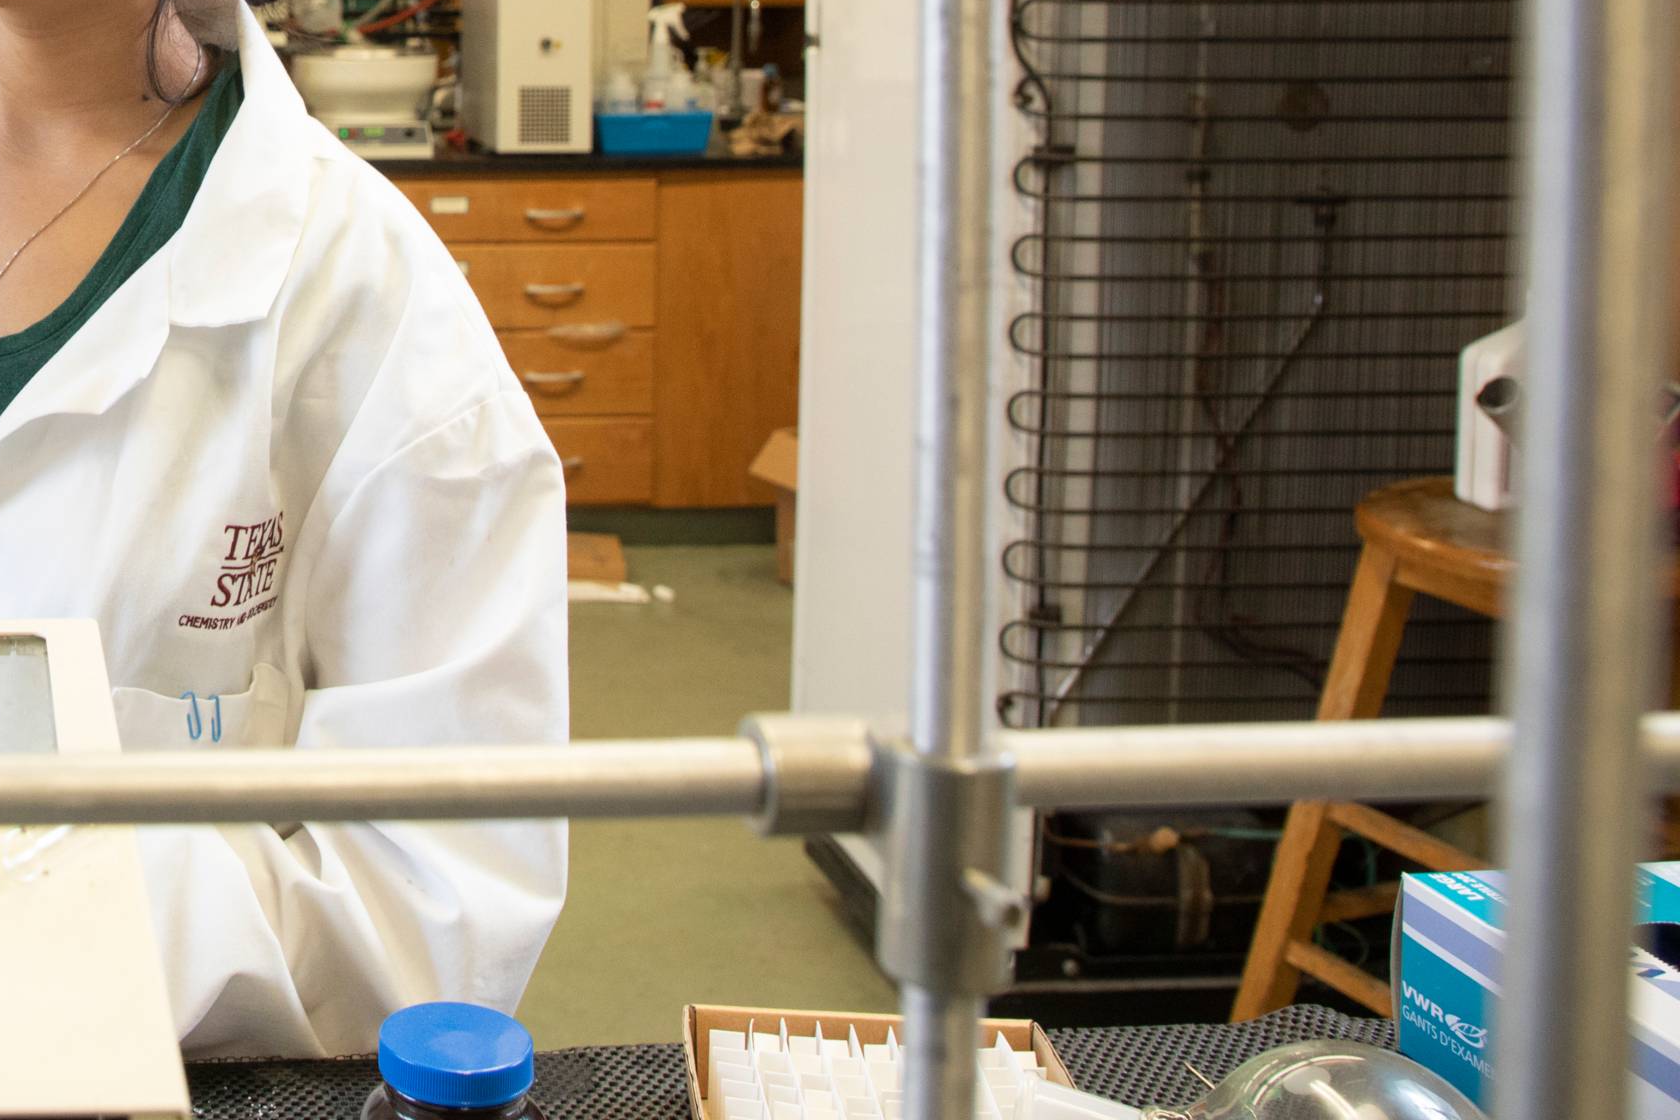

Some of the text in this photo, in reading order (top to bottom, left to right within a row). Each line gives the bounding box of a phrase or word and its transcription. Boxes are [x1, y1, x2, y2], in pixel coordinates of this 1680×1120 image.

[224, 511, 283, 561] TEXAS
[210, 558, 277, 608] STATE
[178, 614, 236, 631] CHEMISTRY
[1402, 980, 1444, 1024] VWR
[1402, 1004, 1495, 1078] GANTS D'EXAME
